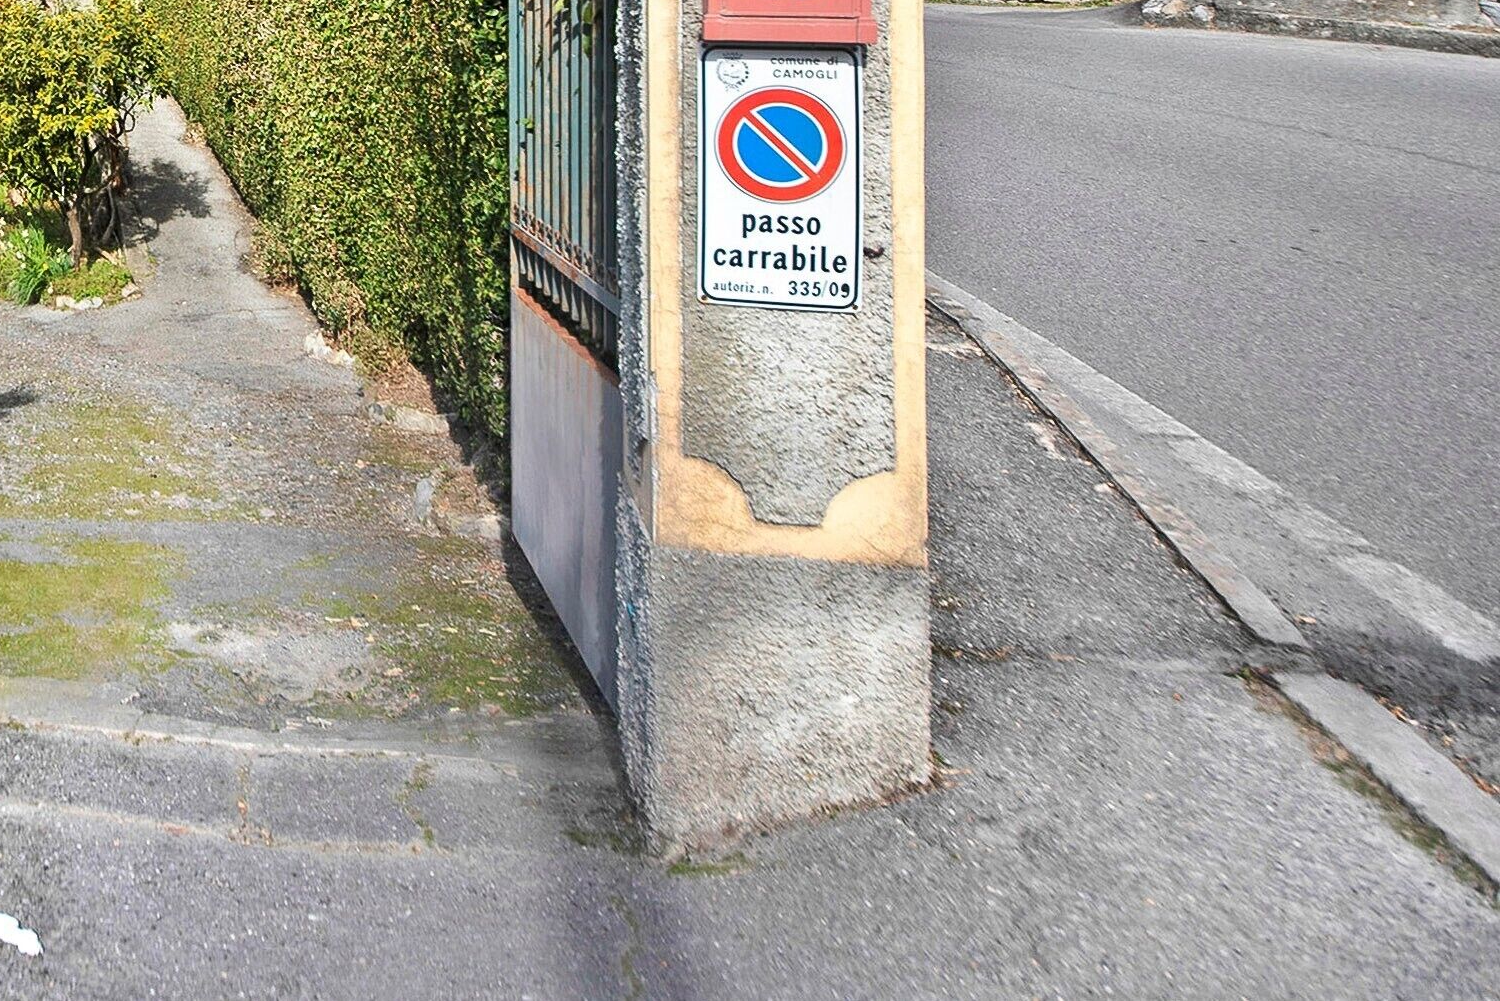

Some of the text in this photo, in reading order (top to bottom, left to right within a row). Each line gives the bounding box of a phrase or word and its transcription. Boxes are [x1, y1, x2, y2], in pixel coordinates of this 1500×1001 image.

[770, 56, 840, 66] comune di
[772, 69, 838, 80] CAMOGLI
[742, 213, 821, 238] passo
[713, 244, 848, 273] carrabile
